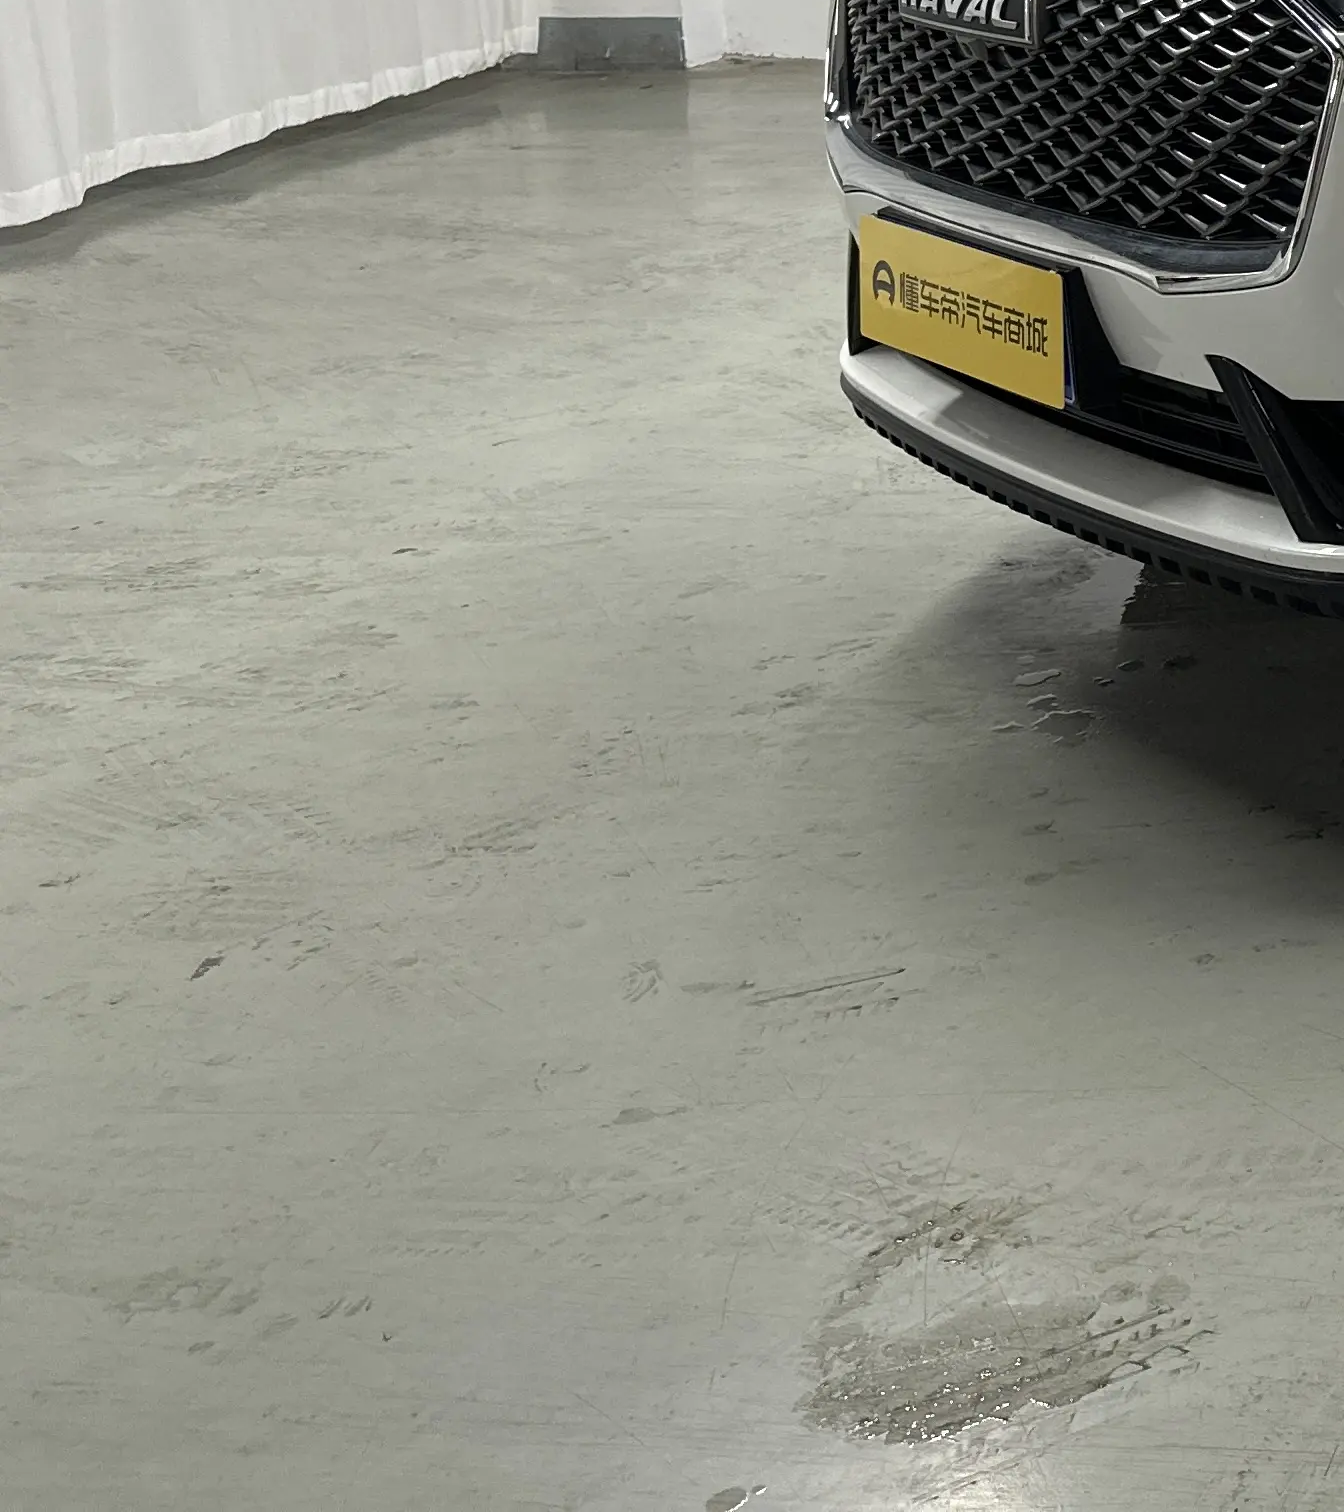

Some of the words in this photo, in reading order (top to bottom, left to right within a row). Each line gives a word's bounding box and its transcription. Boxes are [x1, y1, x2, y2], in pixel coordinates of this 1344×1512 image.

[900, 271, 1049, 357] 懂车帝汽车商城
